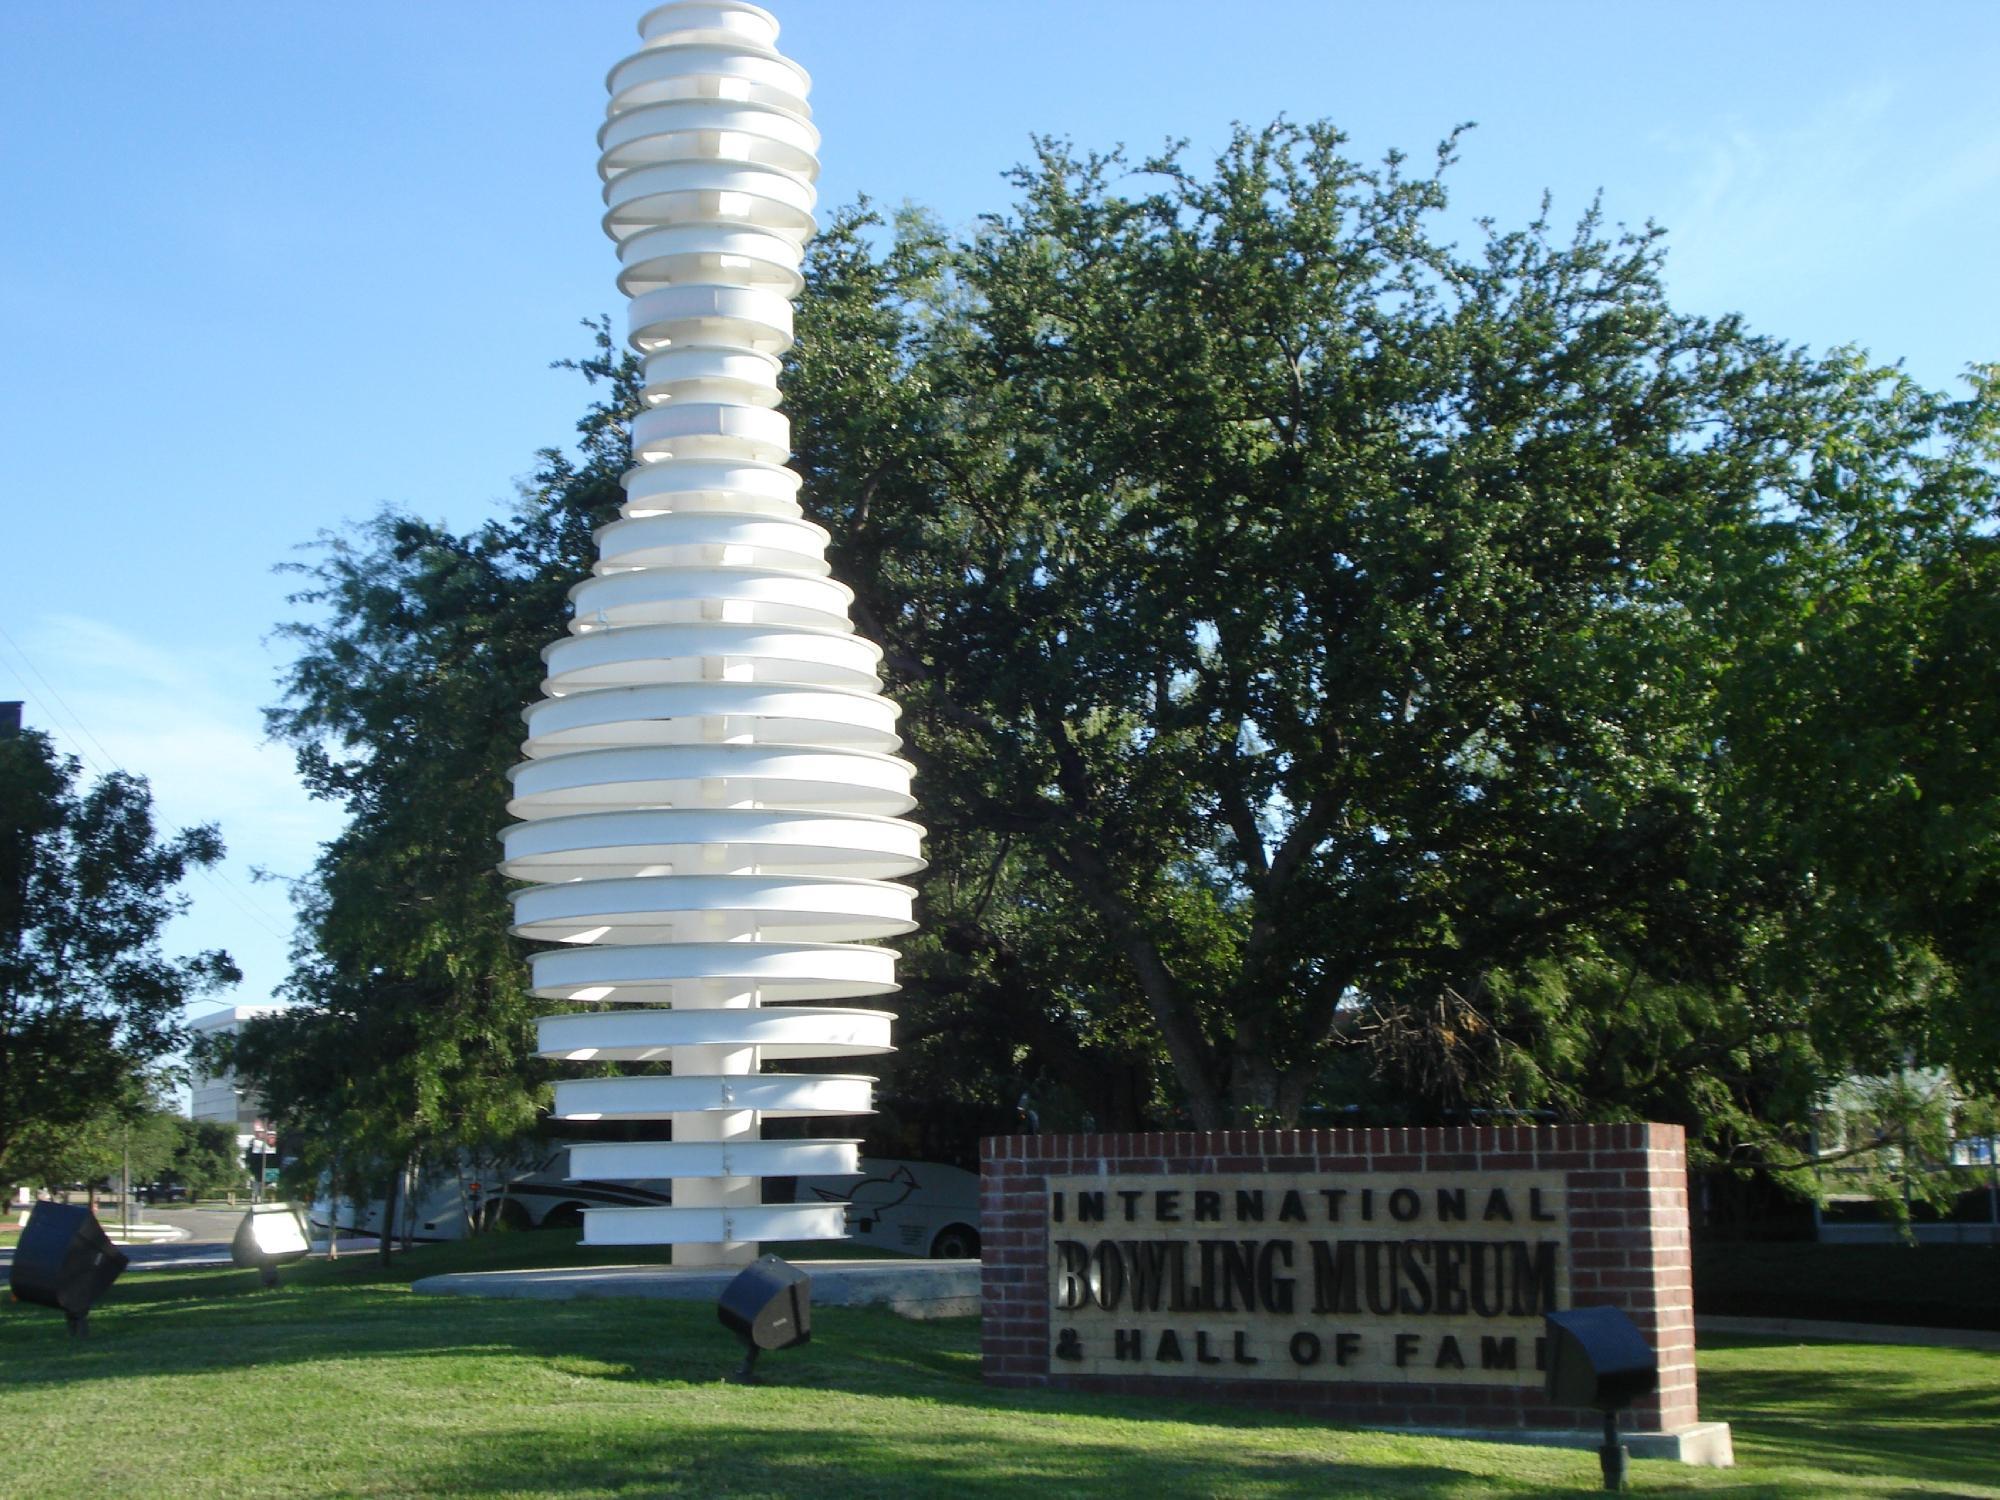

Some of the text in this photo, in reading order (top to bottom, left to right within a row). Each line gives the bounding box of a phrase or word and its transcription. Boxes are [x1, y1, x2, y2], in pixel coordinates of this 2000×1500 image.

[1053, 1188, 1556, 1222] INTERNATIONAL
[1054, 1239, 1560, 1317] BOWLING MUSEUM
[1056, 1327, 1083, 1361] &
[1115, 1329, 1258, 1364] HALL
[1289, 1331, 1362, 1366] OF
